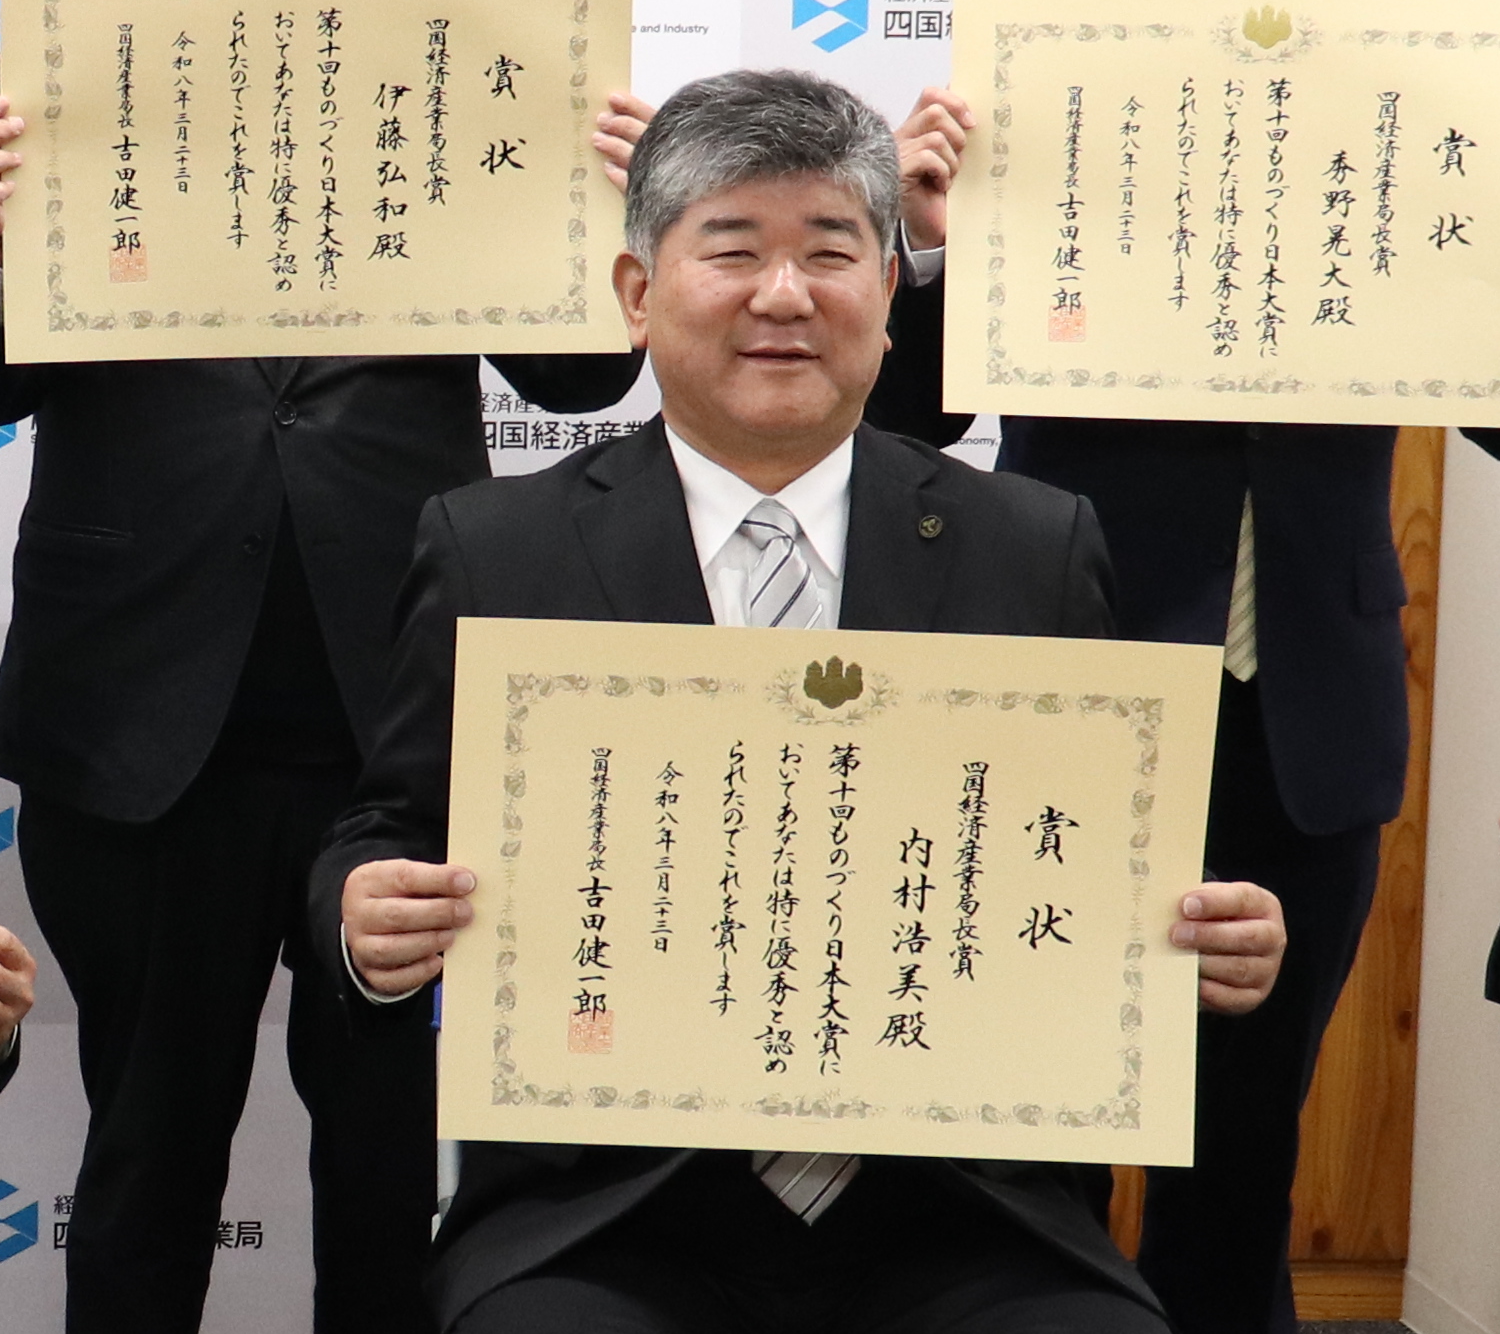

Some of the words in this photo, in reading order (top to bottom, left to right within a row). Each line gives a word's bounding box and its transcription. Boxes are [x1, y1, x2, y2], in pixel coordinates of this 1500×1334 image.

[171, 30, 196, 194] 令和八年三月二十三日
[422, 18, 452, 206] 四国経済産業局長賞
[640, 24, 661, 34] and
[663, 24, 709, 35] Industry
[1117, 95, 1144, 256] 令和八年三月二十三日
[1369, 91, 1402, 278] 四国経済産業局長賞
[650, 760, 684, 954] 令和八年三月二十三日
[948, 761, 990, 982] 四国経済産業局長賞
